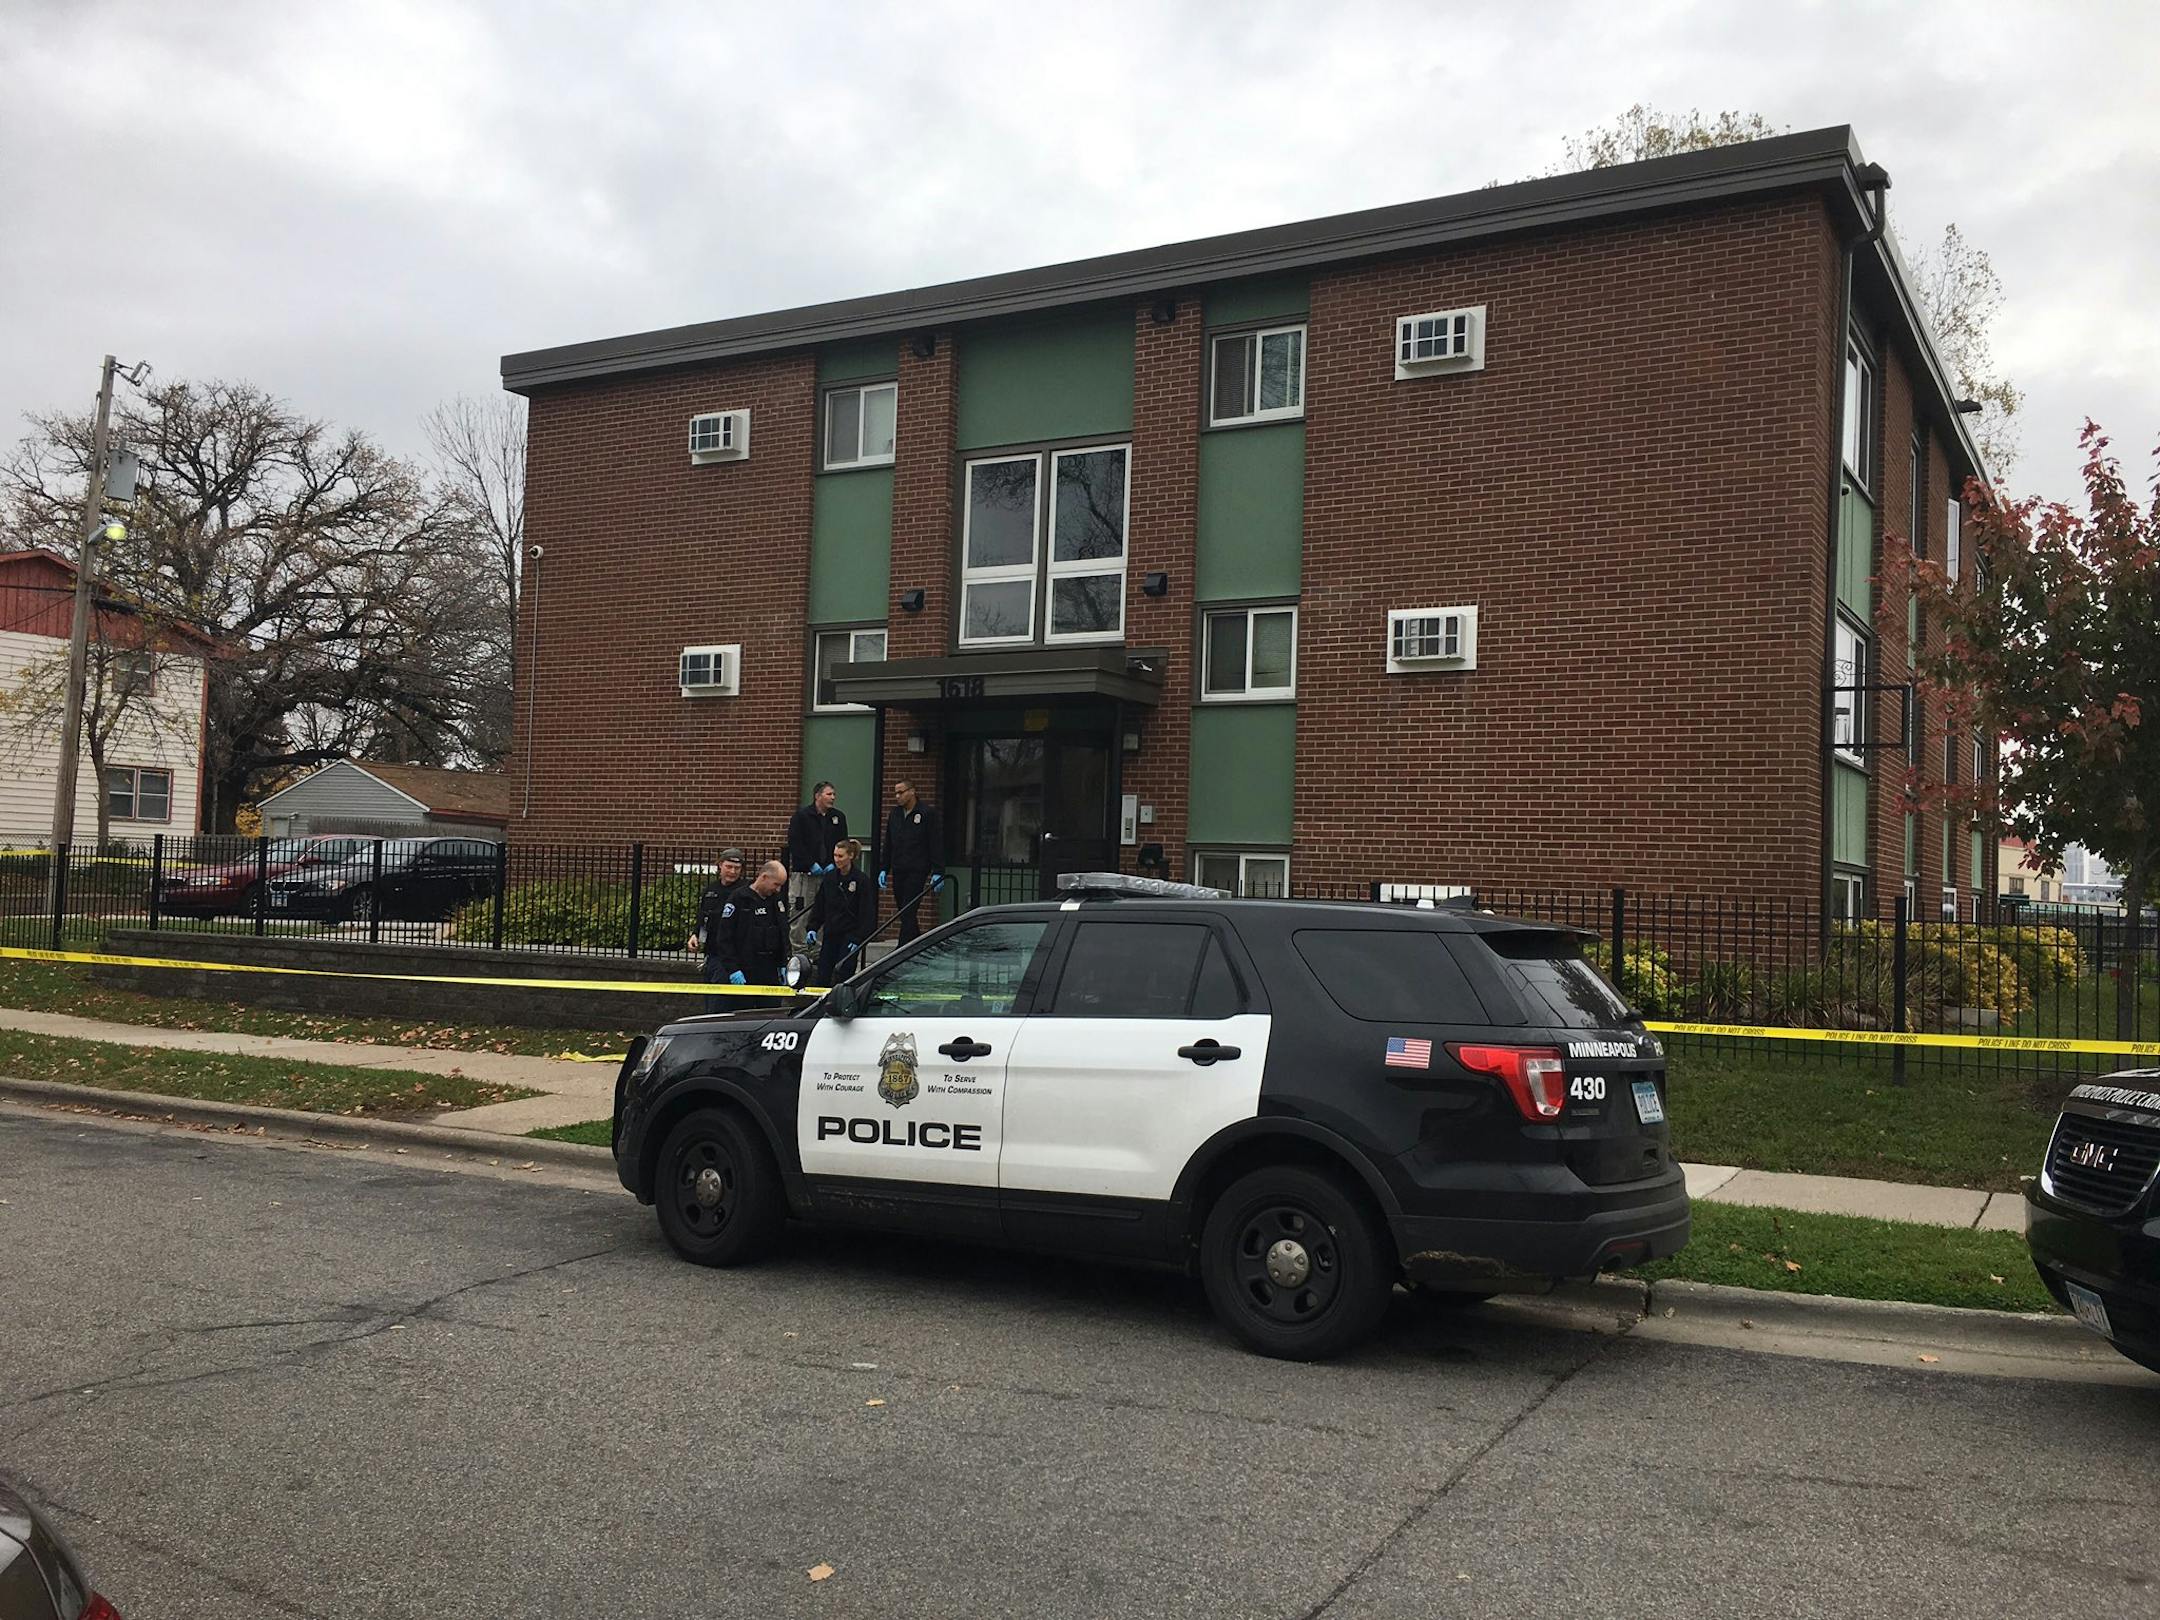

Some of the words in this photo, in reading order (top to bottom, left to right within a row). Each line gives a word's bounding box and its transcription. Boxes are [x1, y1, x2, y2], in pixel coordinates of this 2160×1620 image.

[1673, 1024, 1698, 1032] POLICE
[761, 1031, 799, 1050] 430
[1824, 1031, 1849, 1040] POLICE
[1868, 1033, 1879, 1041] DO
[1880, 1034, 1894, 1042] NOT
[1894, 1035, 1918, 1043] CROSS
[1977, 1038, 2004, 1046] POLICE
[2021, 1040, 2032, 1048] DO
[2032, 1040, 2047, 1048] NOT
[2047, 1041, 2071, 1049] CROSS
[1568, 1041, 1637, 1058] MINNEAPOLIS
[1570, 1077, 1606, 1100] 430
[818, 1116, 982, 1151] POLICE
